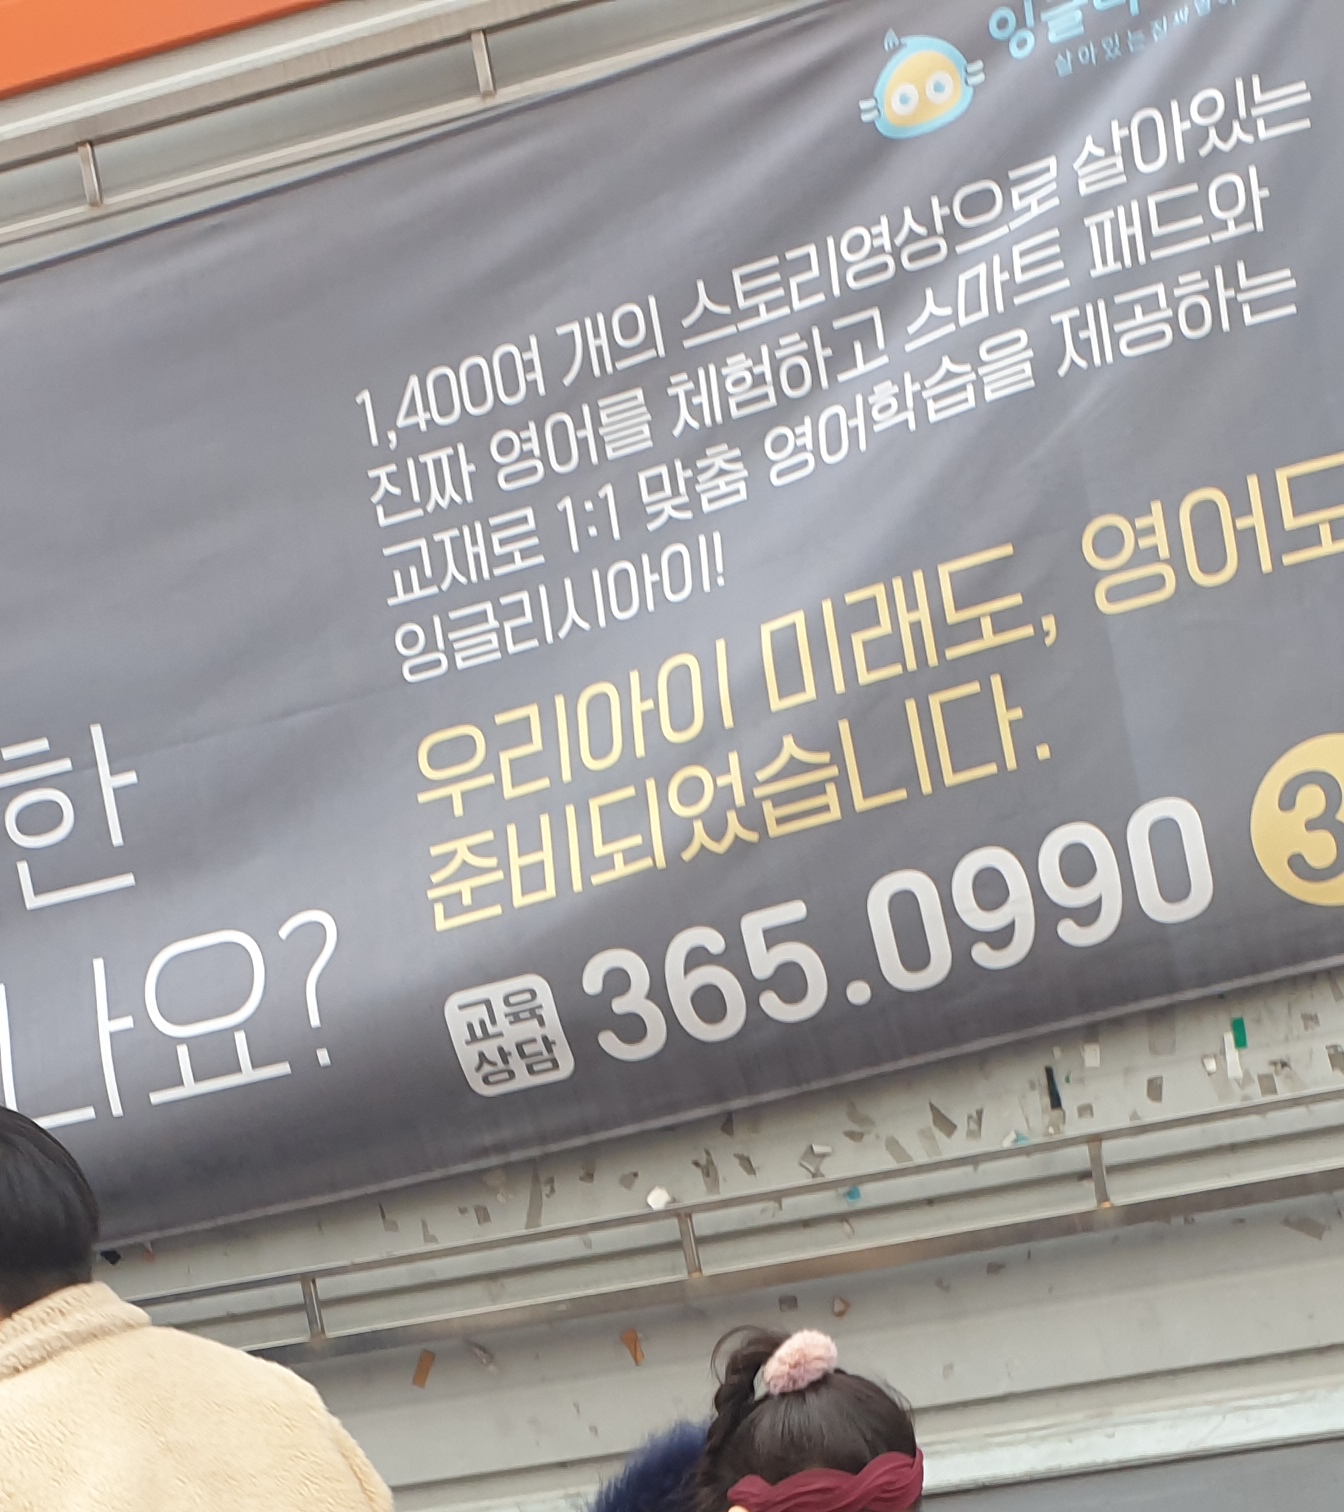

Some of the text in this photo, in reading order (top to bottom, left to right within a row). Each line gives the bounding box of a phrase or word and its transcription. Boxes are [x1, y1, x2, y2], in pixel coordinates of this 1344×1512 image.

[355, 73, 1312, 451] 1,400여 개의 스토리영상으로 살아있는
[367, 164, 1270, 528] 진짜 영어를 체험하고 스마트 패드와
[381, 259, 1298, 607] 교재로 1:1 맞춤 영어학습을 제공하는
[393, 530, 726, 684] 잉글리시아이!
[416, 637, 734, 818] 우리아이
[760, 541, 1057, 713] 미래도,
[426, 672, 1052, 932] 준비되었습니다.
[582, 795, 1215, 1063] 365.0990
[456, 987, 547, 1046] 교육
[473, 1033, 561, 1086] 상담
